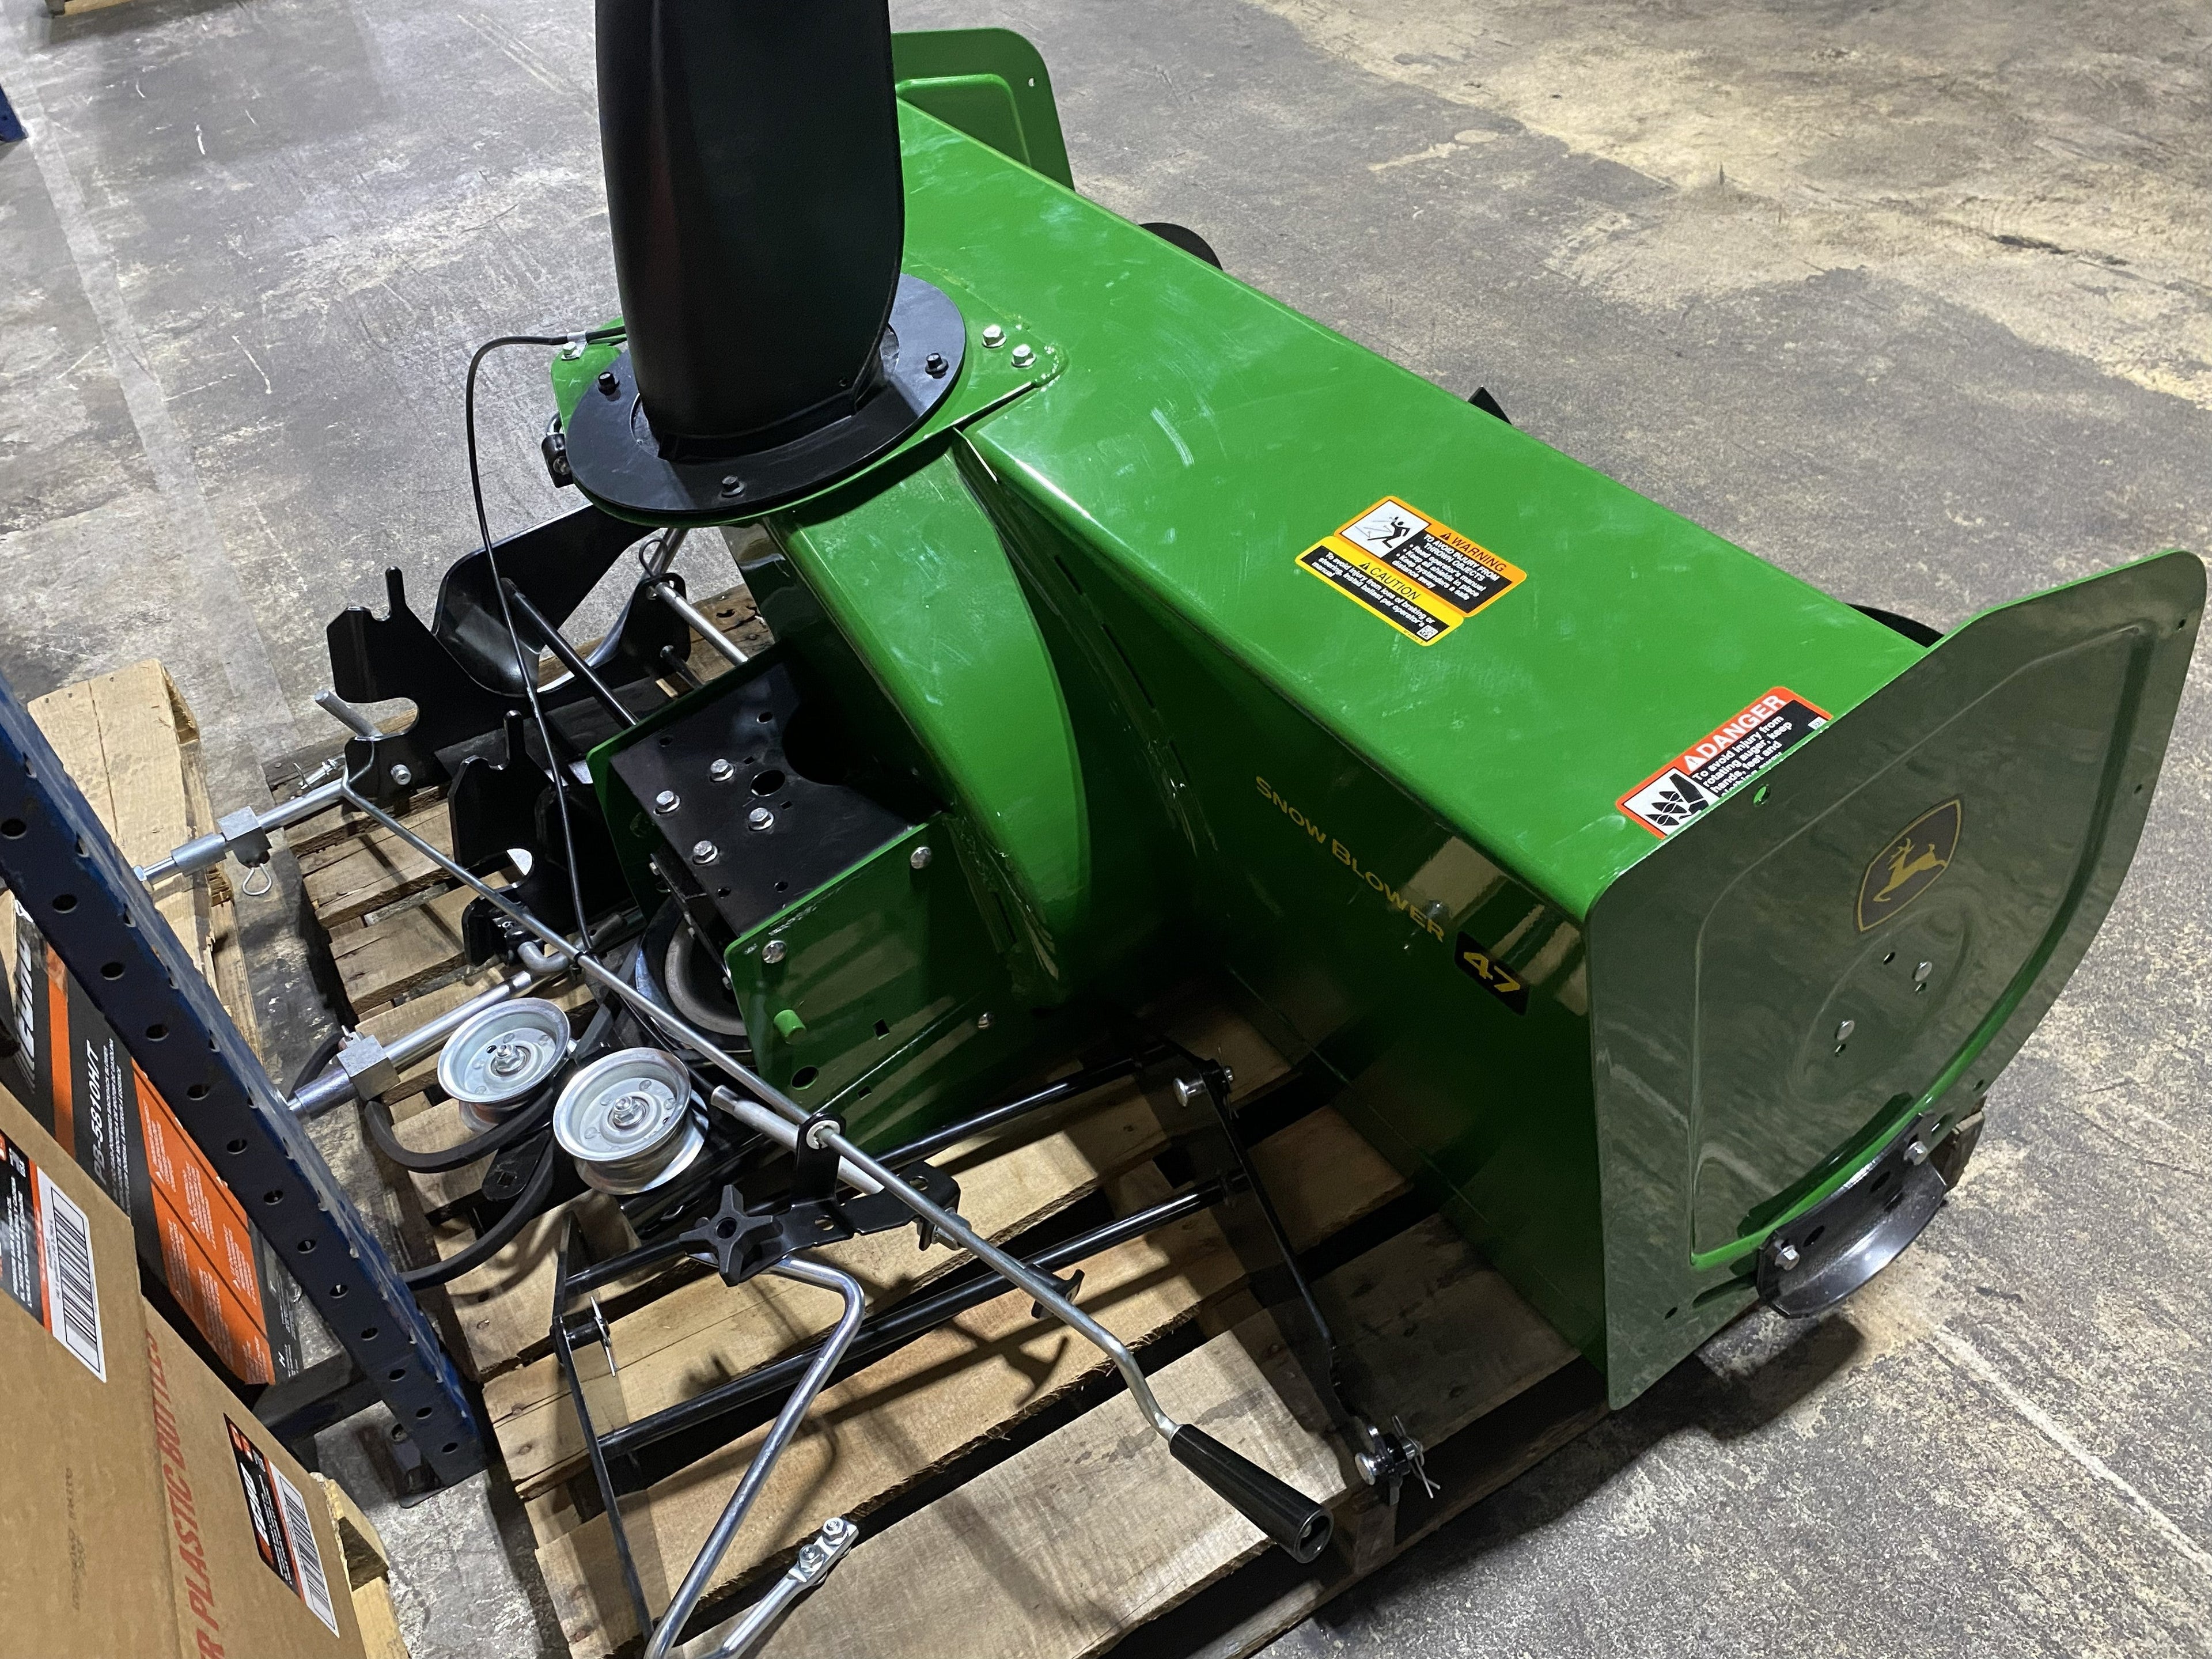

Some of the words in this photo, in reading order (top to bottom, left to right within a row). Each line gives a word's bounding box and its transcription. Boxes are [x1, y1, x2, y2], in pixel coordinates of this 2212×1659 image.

[1311, 561, 1336, 577] manual
[1392, 560, 1419, 578] distance
[1417, 576, 1435, 588] away
[1398, 554, 1416, 567] Keep
[1415, 564, 1450, 588] bystanders
[1454, 588, 1469, 600] safe
[1405, 550, 1423, 562] Keep
[1430, 566, 1454, 582] shields
[1459, 584, 1479, 597] place
[1412, 546, 1431, 558] Read
[1429, 556, 1461, 577] operator's
[1459, 574, 1486, 592] manual
[1423, 533, 1434, 542] TO
[1432, 540, 1455, 554] AVOID
[1452, 551, 1479, 568] INJURY
[1476, 566, 1499, 581] FROM
[1423, 542, 1454, 562] THROWN
[1452, 560, 1485, 581] OBJECTS
[1452, 537, 1506, 571] WARNING
[1325, 551, 1334, 559] To
[1332, 558, 1351, 570] avoid
[1347, 567, 1368, 581] injury
[1365, 578, 1382, 590] from
[1380, 587, 1395, 599] loss
[1401, 601, 1426, 619] braking
[1342, 572, 1363, 586] install
[1360, 584, 1384, 600] ballast
[1379, 597, 1394, 607] per
[1392, 605, 1425, 627] operator's
[1370, 567, 1420, 600] CAUTION
[1692, 770, 1709, 780] To
[1707, 749, 1735, 771] avoid
[1734, 732, 1762, 753] injury
[1759, 715, 1785, 733] from
[1696, 695, 1787, 760] DANGER
[1702, 759, 1742, 787] rotating
[1739, 740, 1771, 760] auger,
[1766, 722, 1792, 740] keep
[1709, 770, 1747, 793] hands,
[1742, 753, 1764, 770] feet
[1762, 740, 1782, 756] and
[1256, 776, 1326, 843] SNOW
[1332, 838, 1444, 943] BLOWER
[1464, 952, 1521, 993] 47
[86, 1039, 106, 1184] PB-5810H/T
[238, 1459, 271, 1548] ECHO
[164, 1464, 219, 1631] PLASTIC
